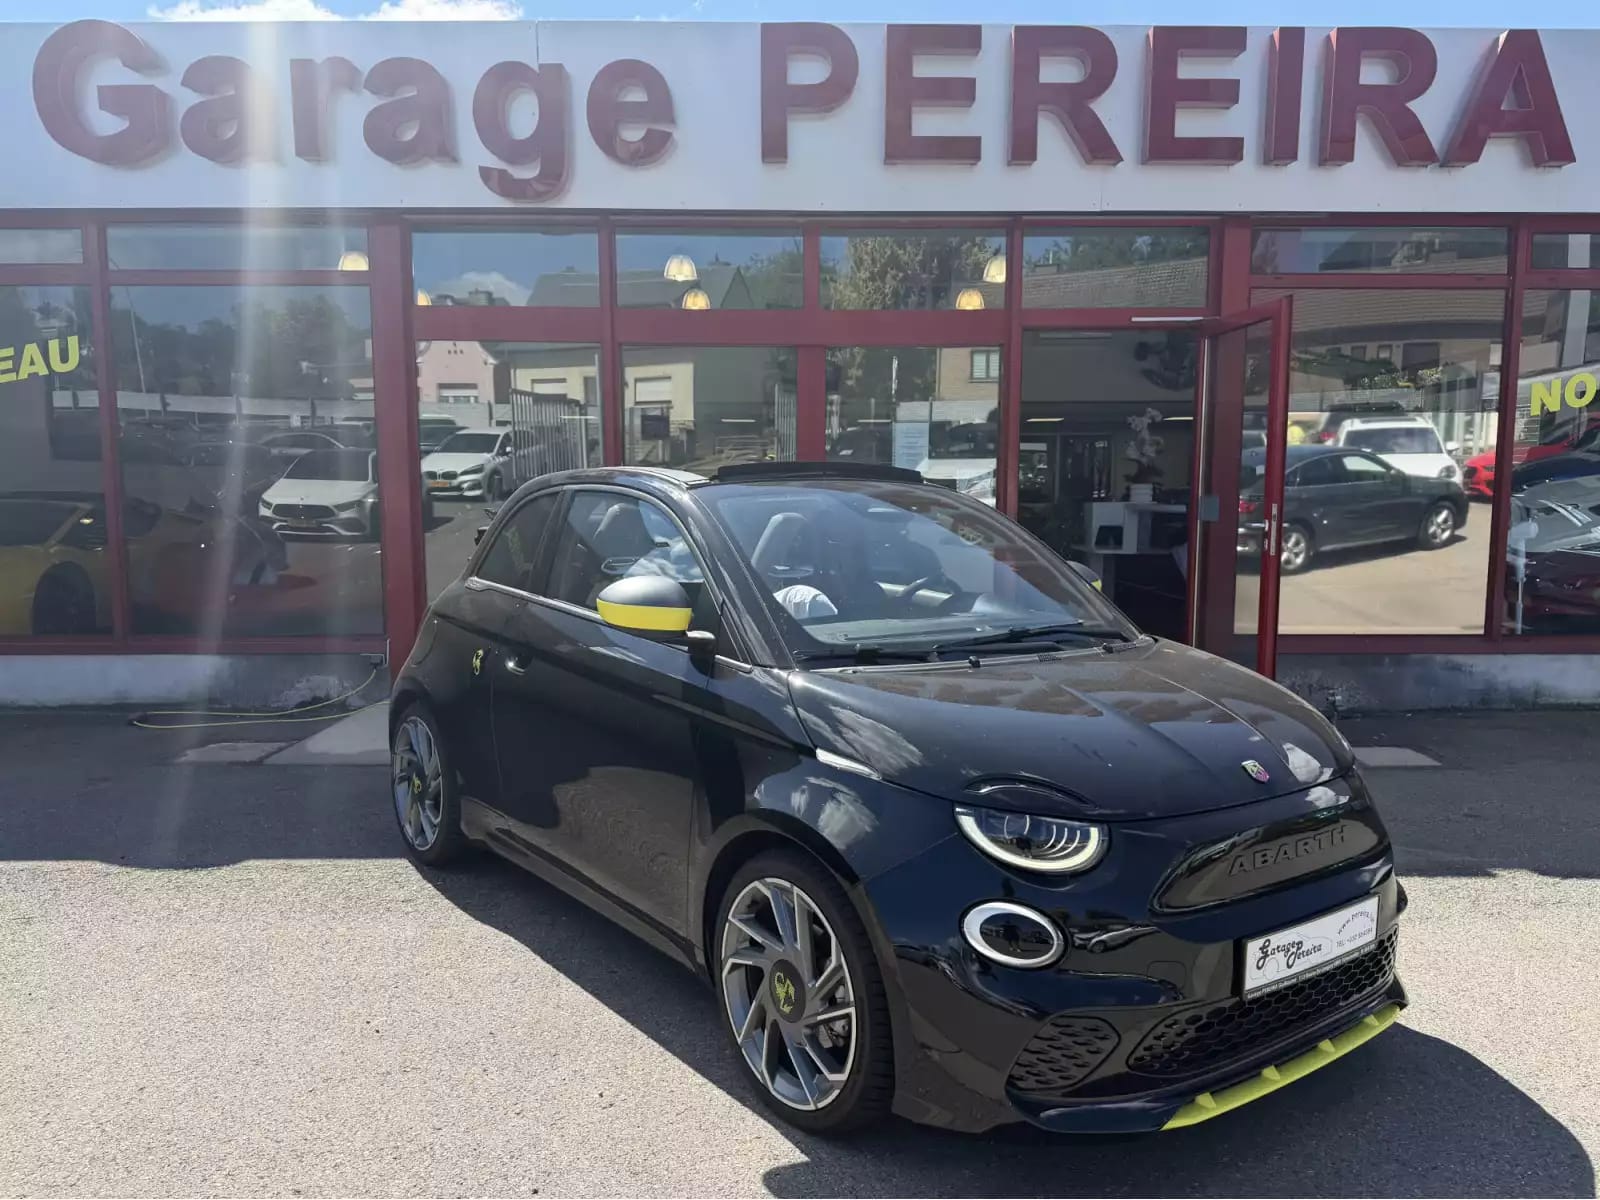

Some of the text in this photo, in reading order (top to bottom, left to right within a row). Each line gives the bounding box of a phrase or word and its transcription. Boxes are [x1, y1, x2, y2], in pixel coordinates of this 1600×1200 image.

[32, 19, 1577, 203] Garage PEREIRA
[0, 335, 79, 383] EAU
[1530, 372, 1597, 416] NO
[1228, 825, 1348, 875] ABARTH
